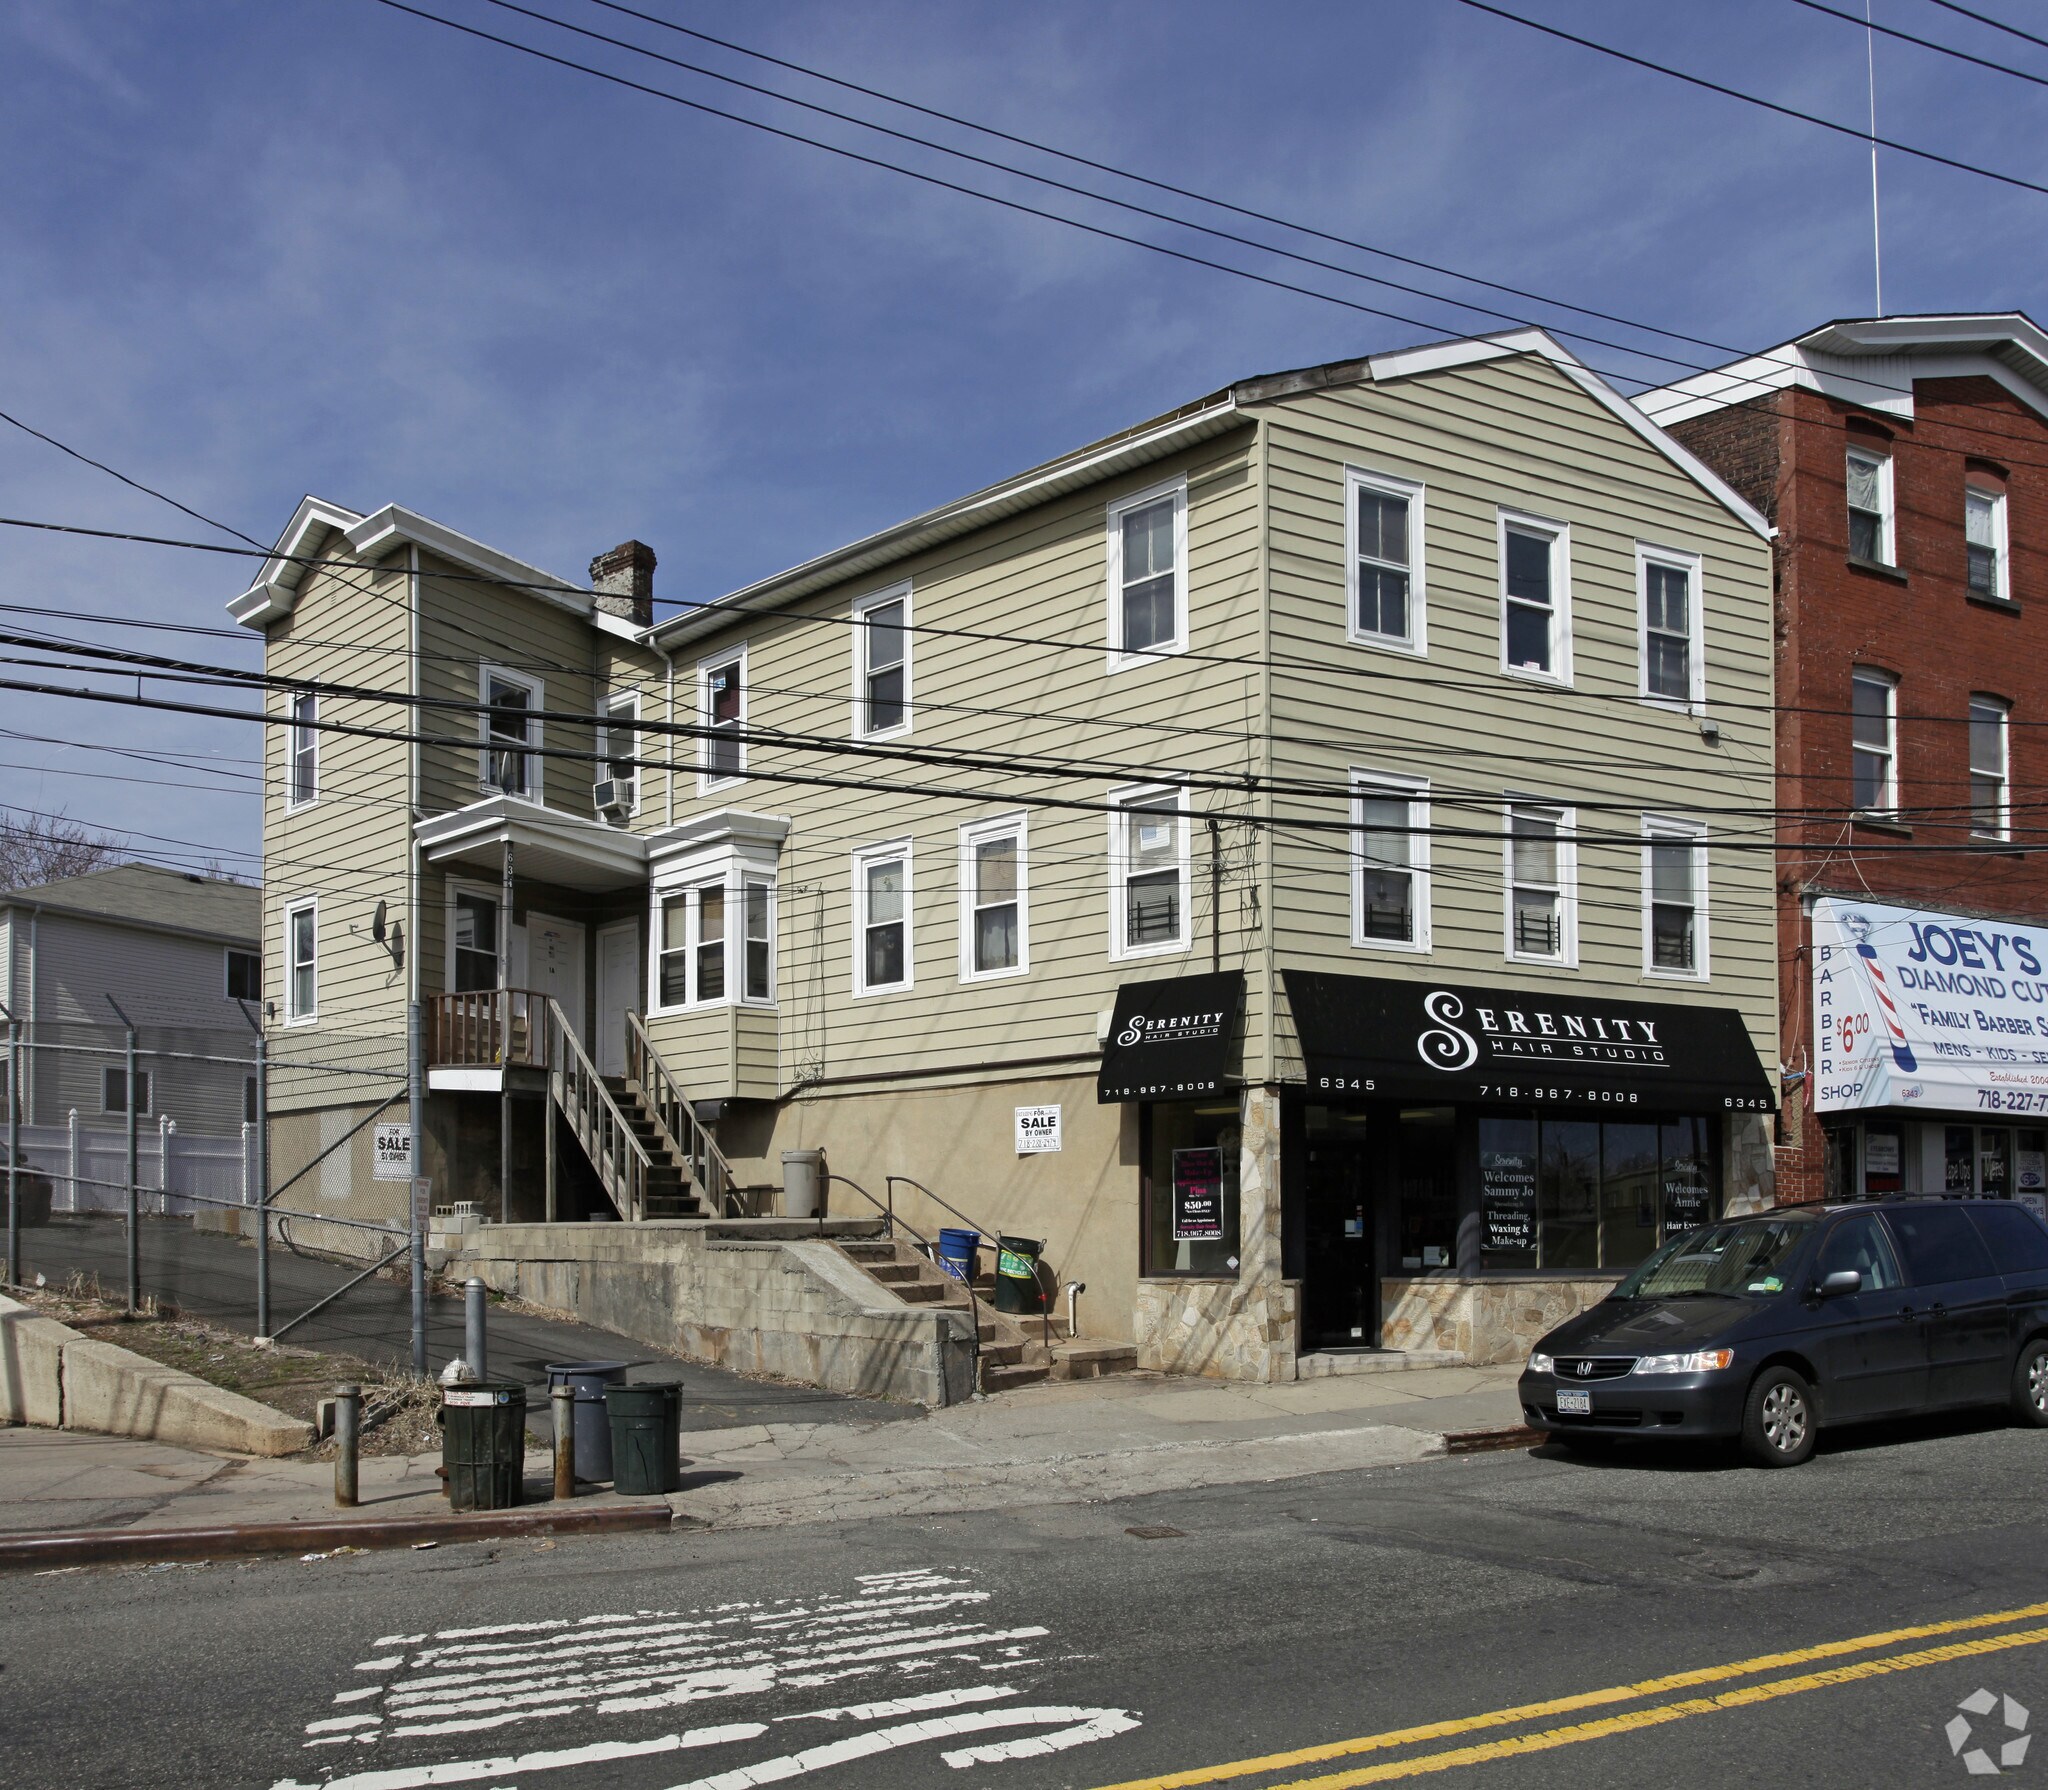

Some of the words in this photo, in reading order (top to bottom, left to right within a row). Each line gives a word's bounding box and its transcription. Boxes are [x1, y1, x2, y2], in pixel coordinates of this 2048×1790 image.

[1908, 922, 2041, 976] JOEY'S
[1896, 966, 2007, 999] DIAMOND
[1117, 1012, 1223, 1046] SERENITY
[1973, 1009, 2036, 1036] BARBER
[2036, 1015, 2048, 1038] S
[1146, 1032, 1170, 1040] HAIR
[1177, 1027, 1219, 1037] STUDIO
[1417, 991, 1659, 1072] SERENITY
[1836, 1013, 1869, 1053] $6.00
[1491, 1040, 1553, 1054] HAIR
[1573, 1045, 1665, 1061] STUDIO
[1933, 1041, 1972, 1058] MENS
[1986, 1046, 2018, 1061] KIDS
[2032, 1050, 2048, 1064] SE
[1320, 1077, 1375, 1090] 6345
[1989, 1071, 2028, 1083] Established
[1104, 1082, 1215, 1096] 718-967-8008
[1479, 1085, 1638, 1103] 718-967-8008
[1821, 1082, 1863, 1100] SHOP
[1724, 1097, 1767, 1109] 6345
[1977, 1089, 2048, 1112] 718-227-7
[1021, 1116, 1056, 1129] SALE
[1034, 1128, 1052, 1136] OWNER
[378, 1137, 410, 1151] SALE
[1484, 1171, 1535, 1183] Welcomes
[1484, 1185, 1520, 1199] Sammy
[1522, 1185, 1534, 1196] Jo
[1665, 1182, 1709, 1194] Welcomes
[1184, 1200, 1212, 1210] $50.00
[1675, 1197, 1701, 1207] Annie
[1487, 1211, 1531, 1222] Threading,
[1489, 1223, 1521, 1236] Waxing
[1522, 1223, 1529, 1233] &
[1666, 1221, 1682, 1230] Hair
[1492, 1236, 1527, 1247] Make-up
